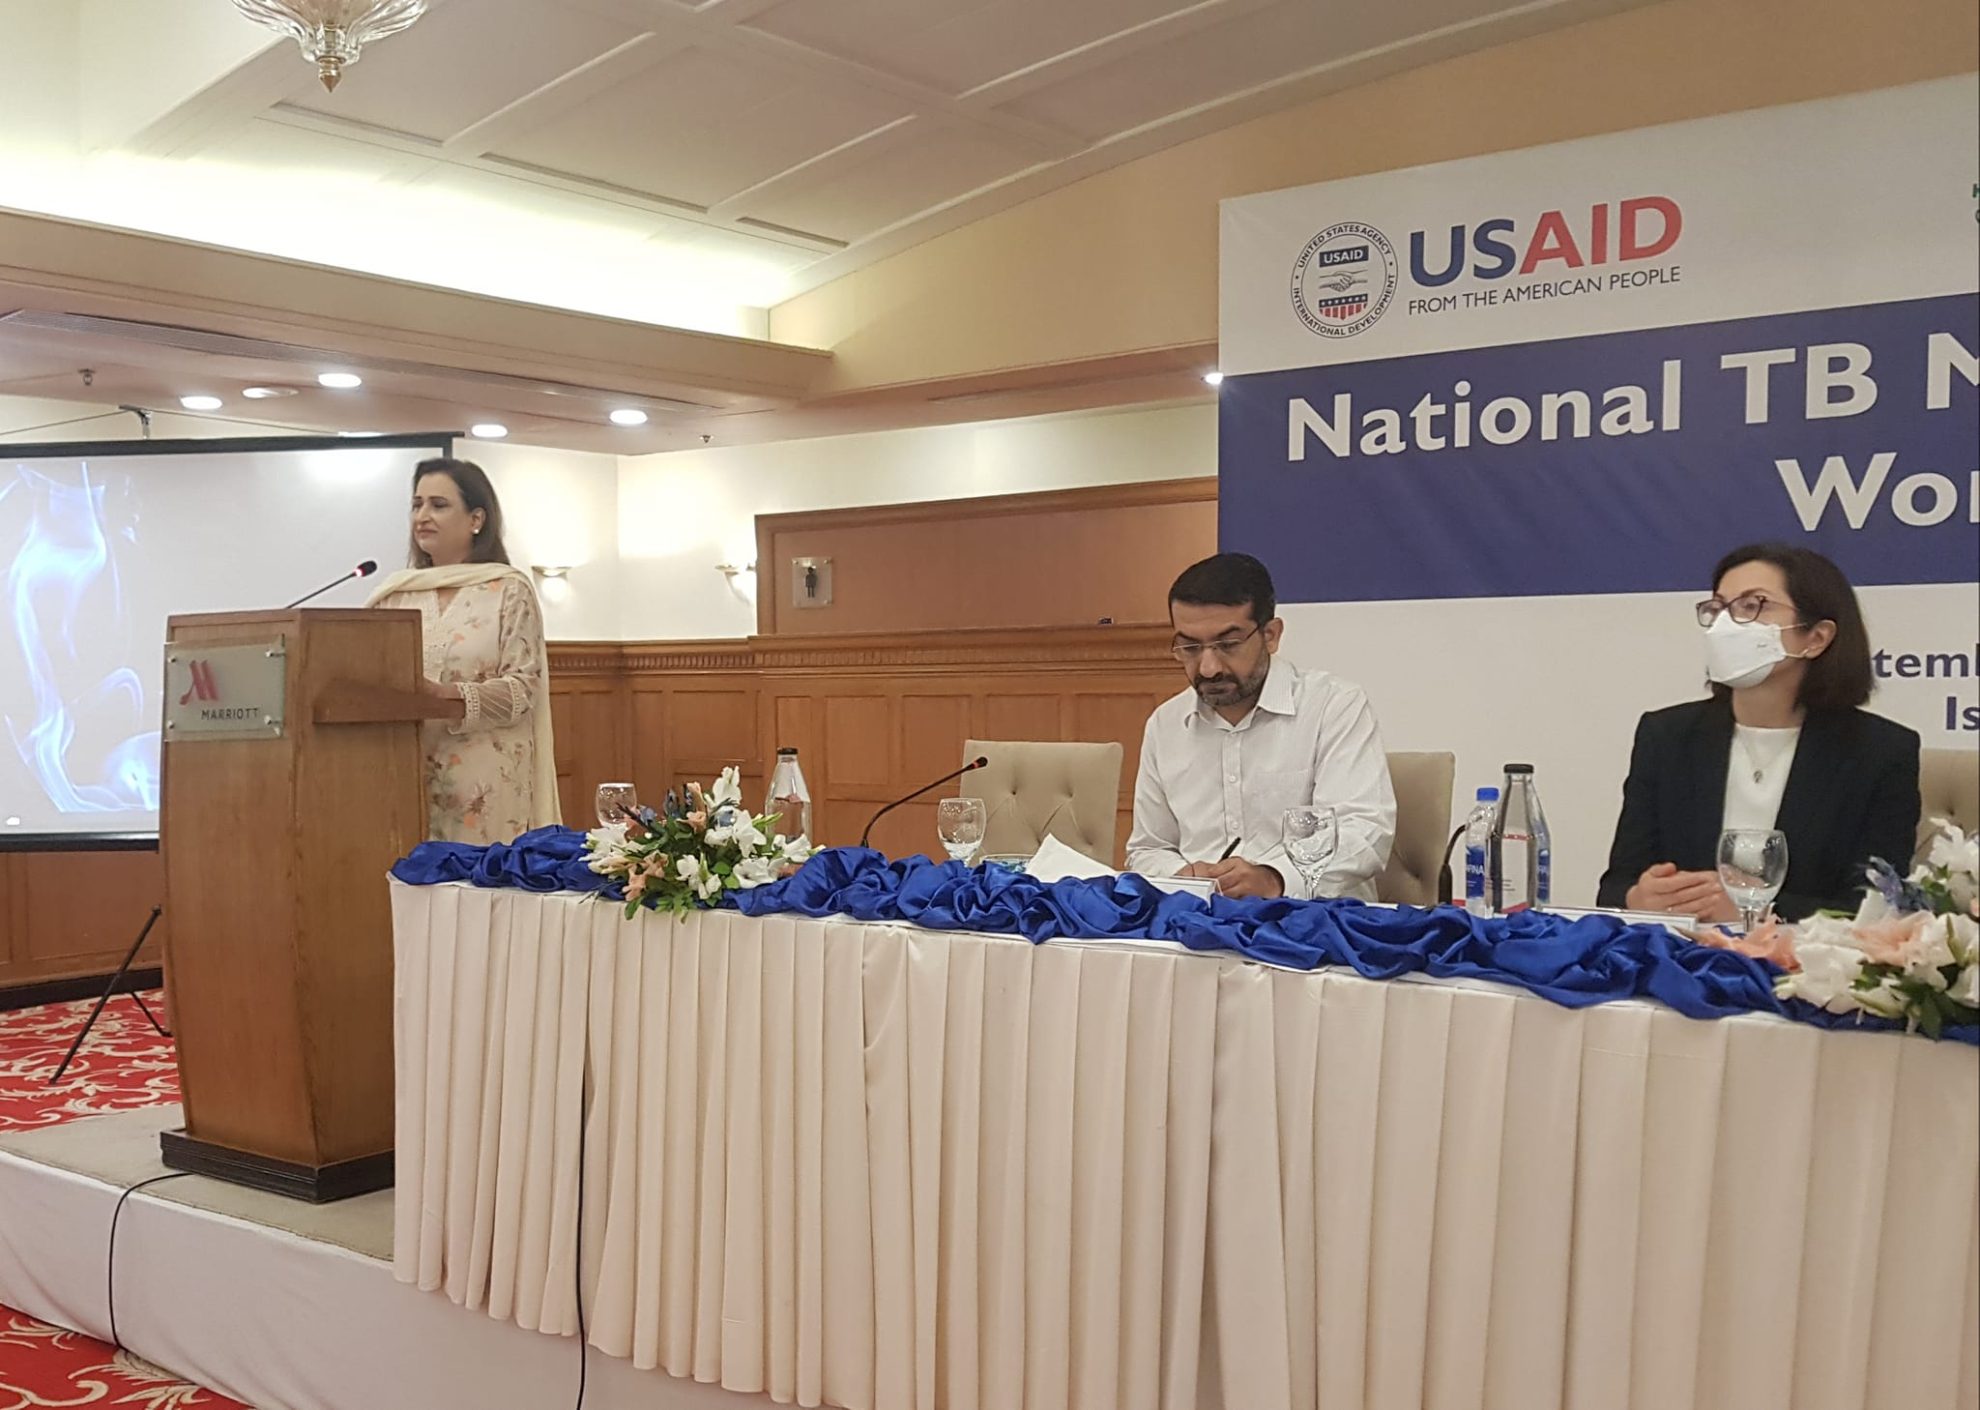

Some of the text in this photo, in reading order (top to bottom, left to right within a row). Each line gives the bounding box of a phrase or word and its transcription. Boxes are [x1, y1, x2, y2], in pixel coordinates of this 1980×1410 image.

[1298, 225, 1392, 268] UNITED STATES AGENCY
[1323, 249, 1364, 264] USAID
[1409, 196, 1682, 287] USAID
[1293, 274, 1395, 336] INTERNATIONAL DEVELOPMENT
[1408, 266, 1681, 315] FROM THE AMERICAN PEOPLE
[1288, 359, 1682, 462] National
[1720, 342, 1878, 424] TB
[1872, 643, 1980, 678] tem
[201, 707, 259, 720] MARRIOTT
